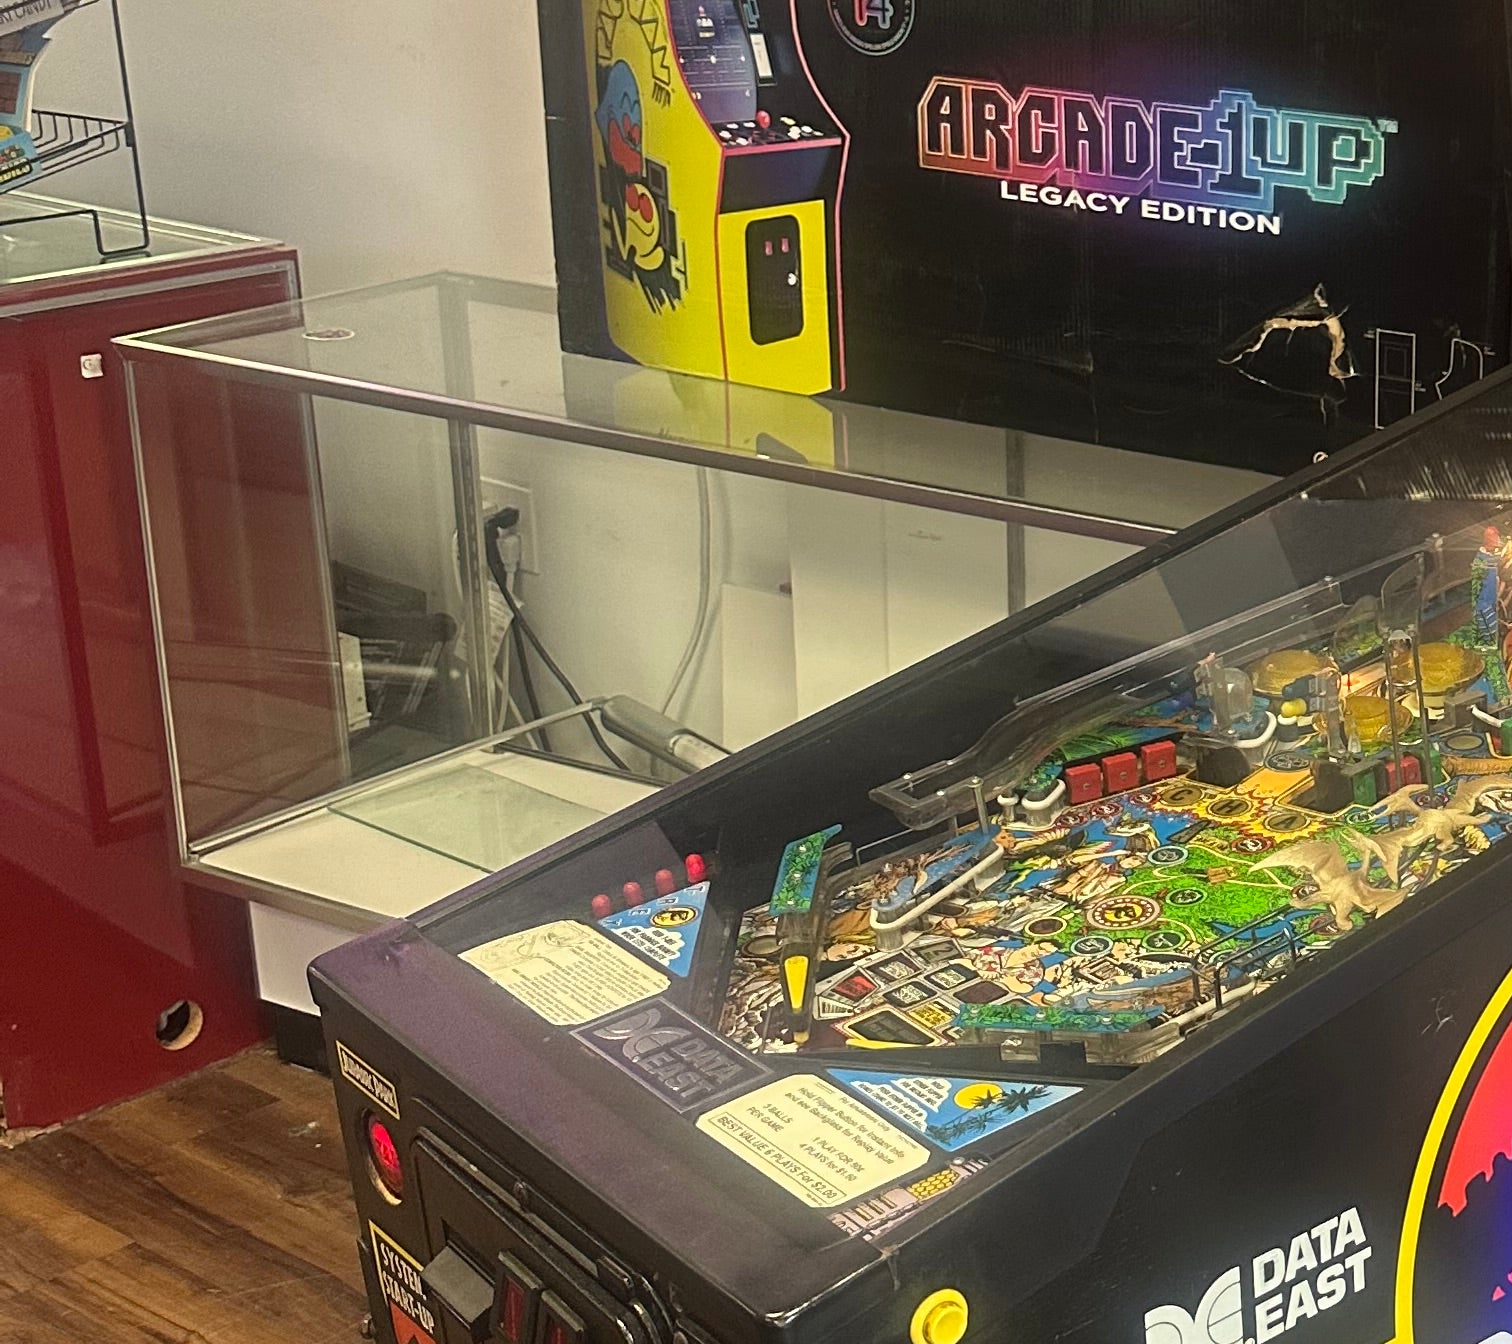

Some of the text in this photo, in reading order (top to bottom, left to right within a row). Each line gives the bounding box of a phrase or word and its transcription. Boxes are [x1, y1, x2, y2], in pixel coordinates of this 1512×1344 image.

[1000, 180, 1281, 236] LEGACY EDITION
[635, 1051, 716, 1098] EAST
[670, 1037, 744, 1085] DATA
[716, 1116, 740, 1132] BEST
[739, 1129, 768, 1151] VALUE
[771, 1152, 800, 1174] PLAYS
[798, 1170, 814, 1185] For
[761, 1115, 785, 1132] GAME
[1252, 1206, 1367, 1299] DATA
[382, 1270, 436, 1335] START-UP
